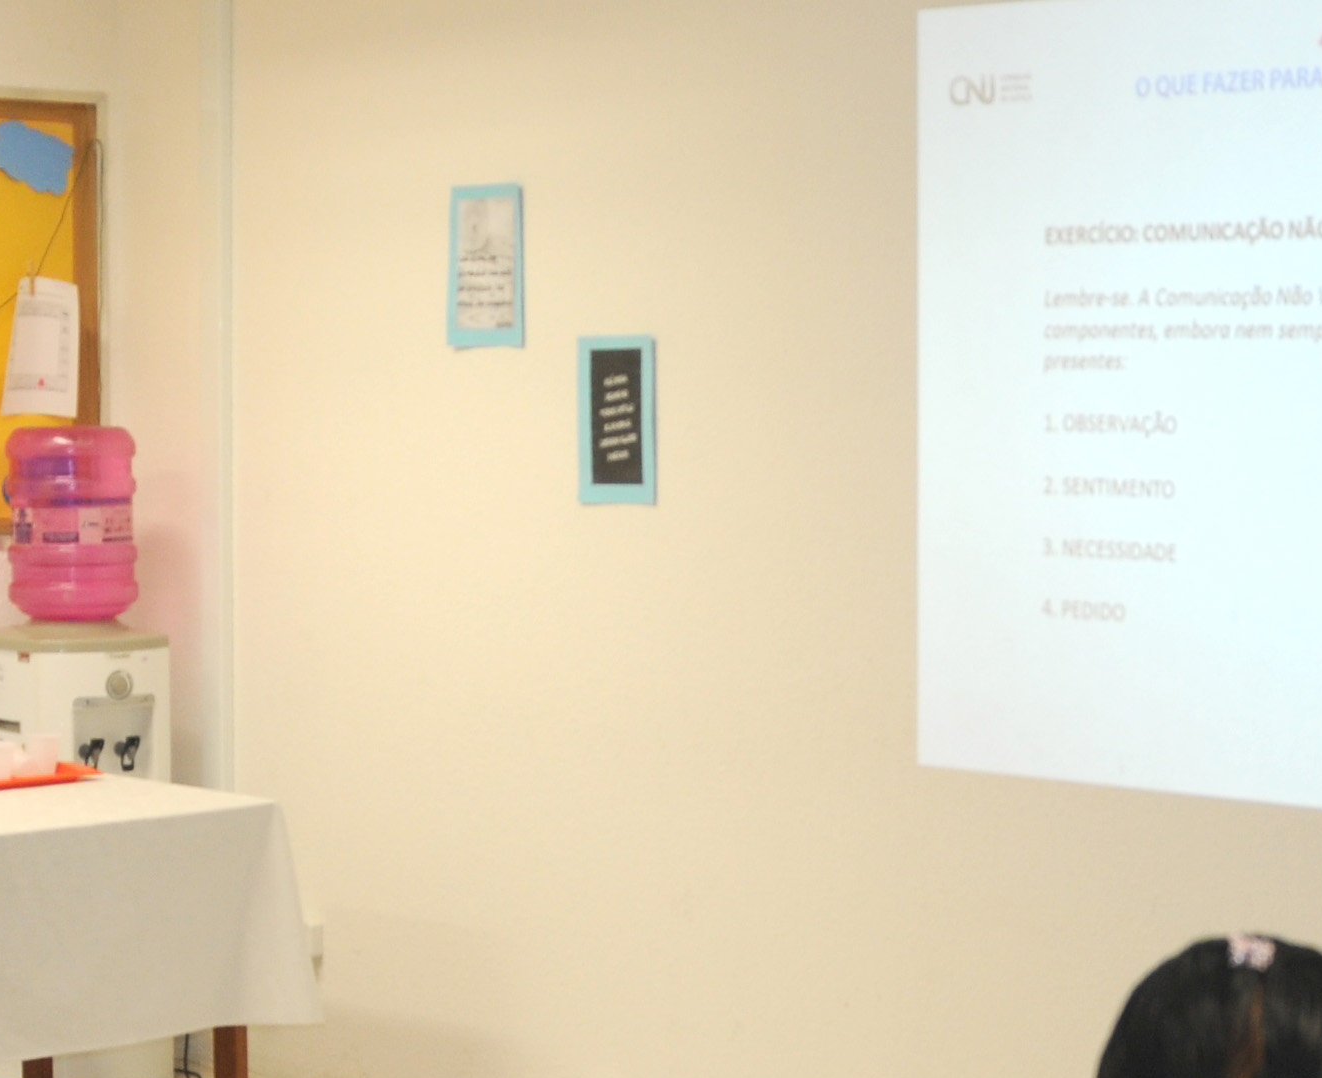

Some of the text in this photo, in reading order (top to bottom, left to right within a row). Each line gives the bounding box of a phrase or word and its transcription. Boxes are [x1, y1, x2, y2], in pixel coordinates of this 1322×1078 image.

[950, 74, 995, 105] CNJ
[1136, 77, 1150, 98] O
[1156, 74, 1197, 97] QUE
[1203, 69, 1264, 94] FAZER
[1046, 221, 1138, 246] EXERCÍCIO:
[1143, 217, 1285, 245] COMUNICAÇÃO
[1138, 288, 1150, 306] A
[1156, 284, 1273, 310] Comunicação
[1277, 284, 1313, 306] Não
[1044, 323, 1157, 343] componentes,
[1164, 318, 1230, 339] embora
[1235, 323, 1273, 339] nem
[1044, 354, 1126, 373] presentes:
[1044, 411, 1177, 437] 1. OBSERVAÇÃO
[1044, 476, 1175, 499] 2. SENTIMENTO
[1044, 537, 1177, 563] 3. NECESSIDADE
[1043, 599, 1126, 622] 4. PEDIDO
